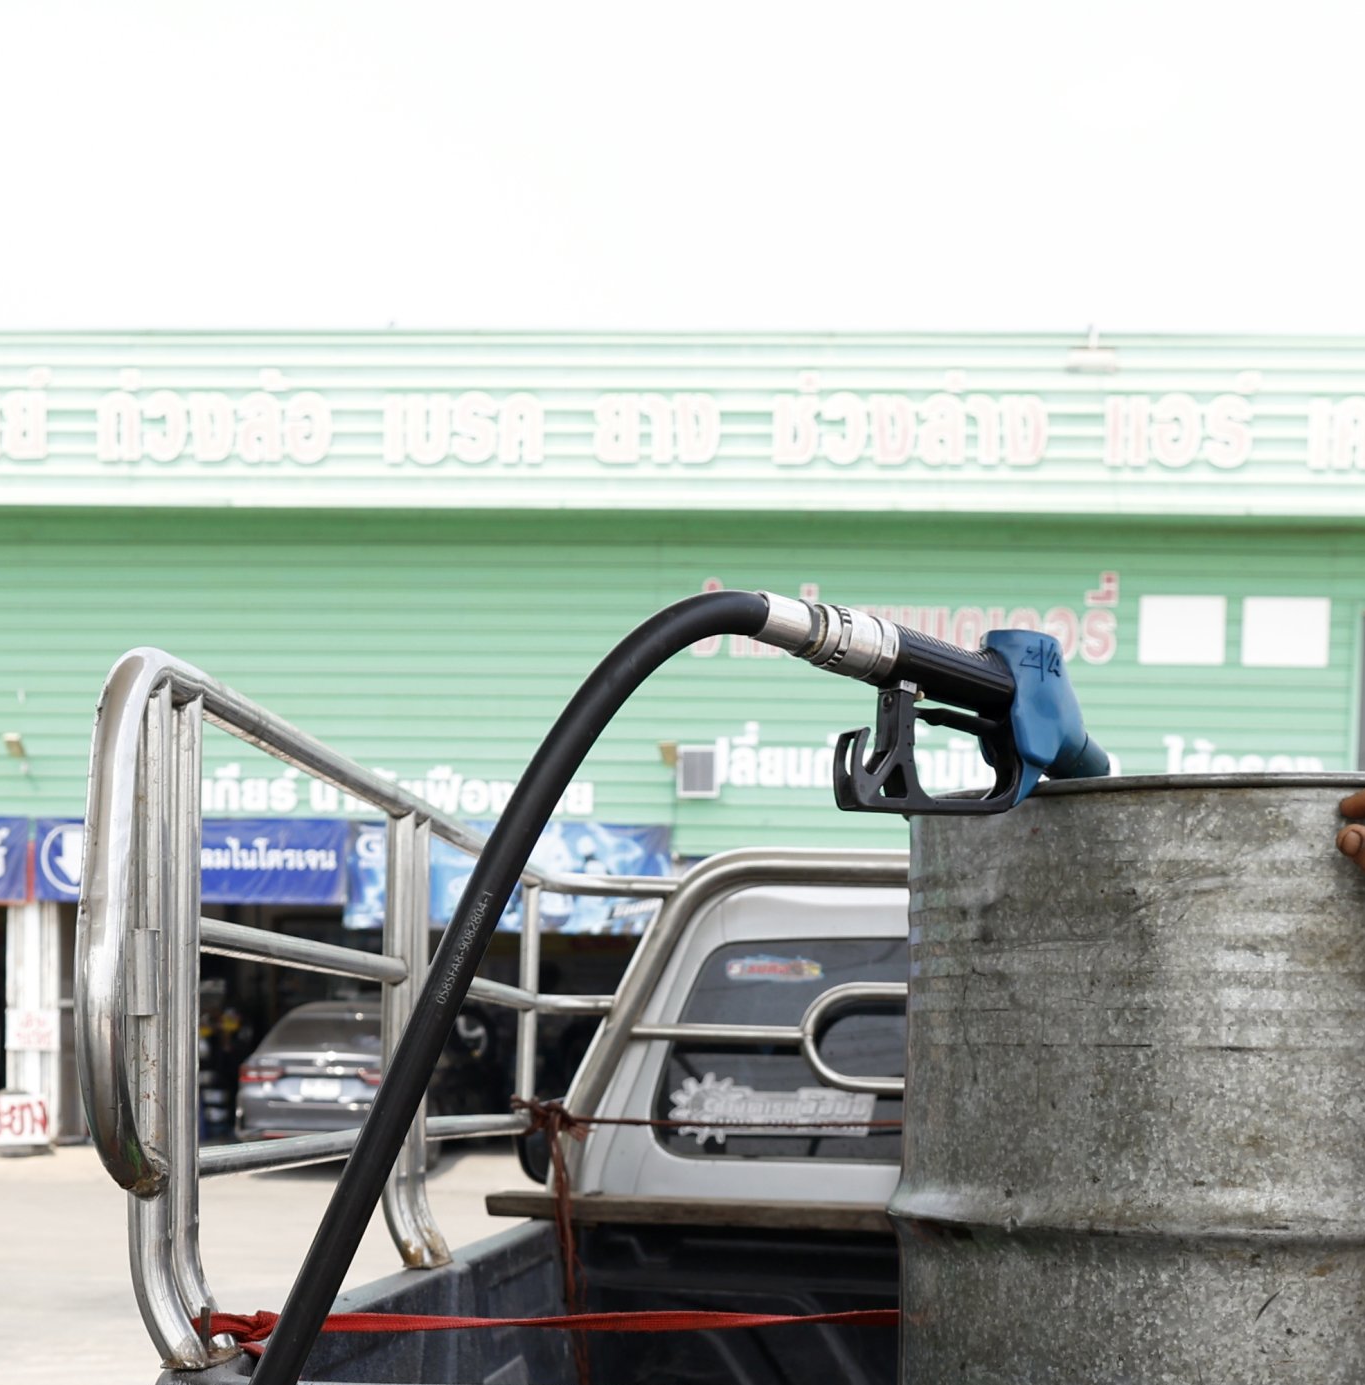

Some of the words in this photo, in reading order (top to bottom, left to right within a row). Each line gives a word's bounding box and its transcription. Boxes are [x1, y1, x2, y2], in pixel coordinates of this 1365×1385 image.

[95, 369, 332, 466] ถ่วงล้อ
[593, 391, 721, 467] ยาง
[770, 371, 1051, 468] ช่วงล่าง
